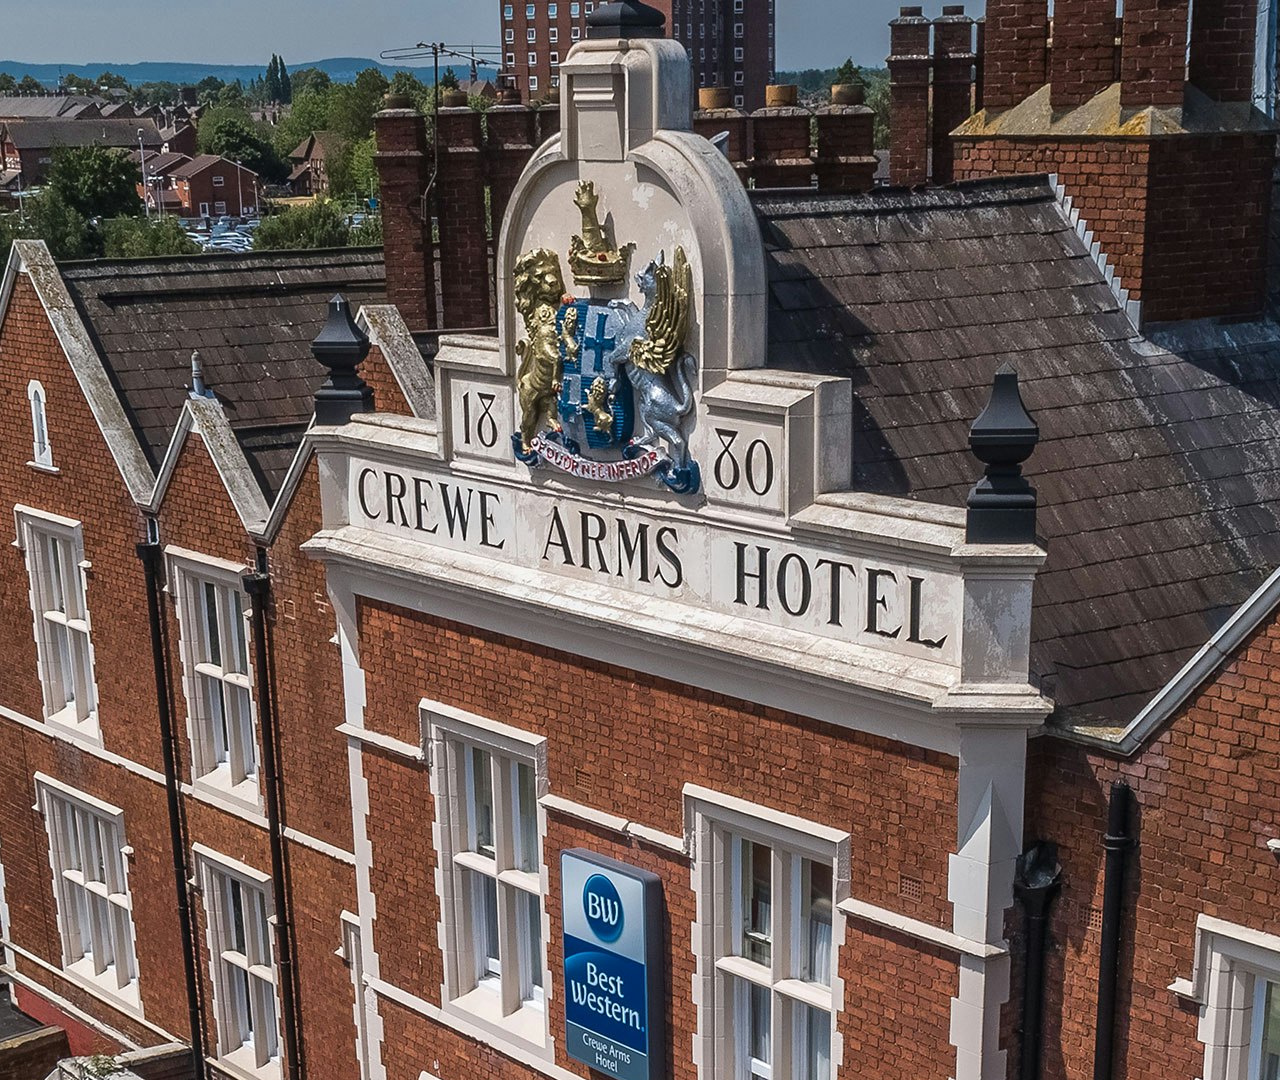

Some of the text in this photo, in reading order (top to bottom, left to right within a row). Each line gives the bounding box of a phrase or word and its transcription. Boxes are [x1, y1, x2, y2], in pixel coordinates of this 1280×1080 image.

[462, 391, 499, 448] 18
[607, 451, 660, 480] INFERIOR
[714, 428, 775, 496] 80
[357, 466, 950, 650] CREWE ARMS HOTEL
[587, 891, 619, 926] BW
[586, 961, 624, 998] Best
[582, 1032, 631, 1064] Crewe Arms
[595, 1053, 618, 1073] Hotel
